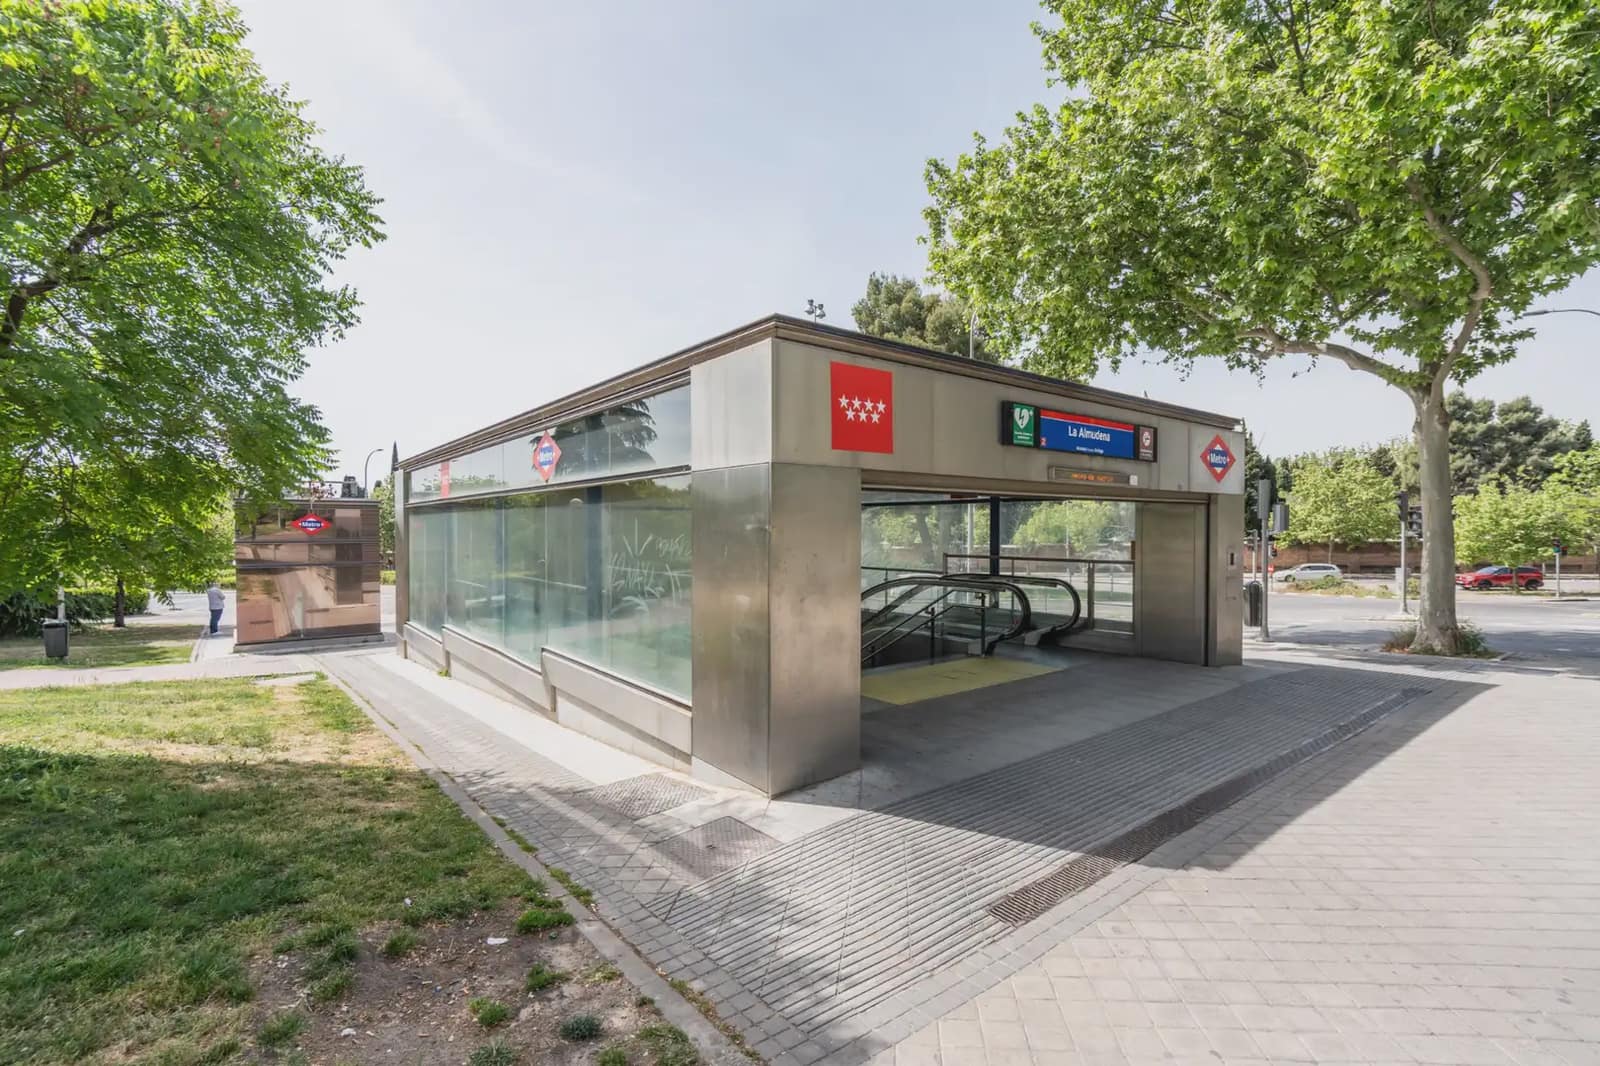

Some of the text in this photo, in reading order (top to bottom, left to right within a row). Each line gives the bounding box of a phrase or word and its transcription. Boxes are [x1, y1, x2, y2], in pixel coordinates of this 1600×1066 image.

[1068, 425, 1110, 442] La Almudena
[1210, 453, 1226, 465] Metro
